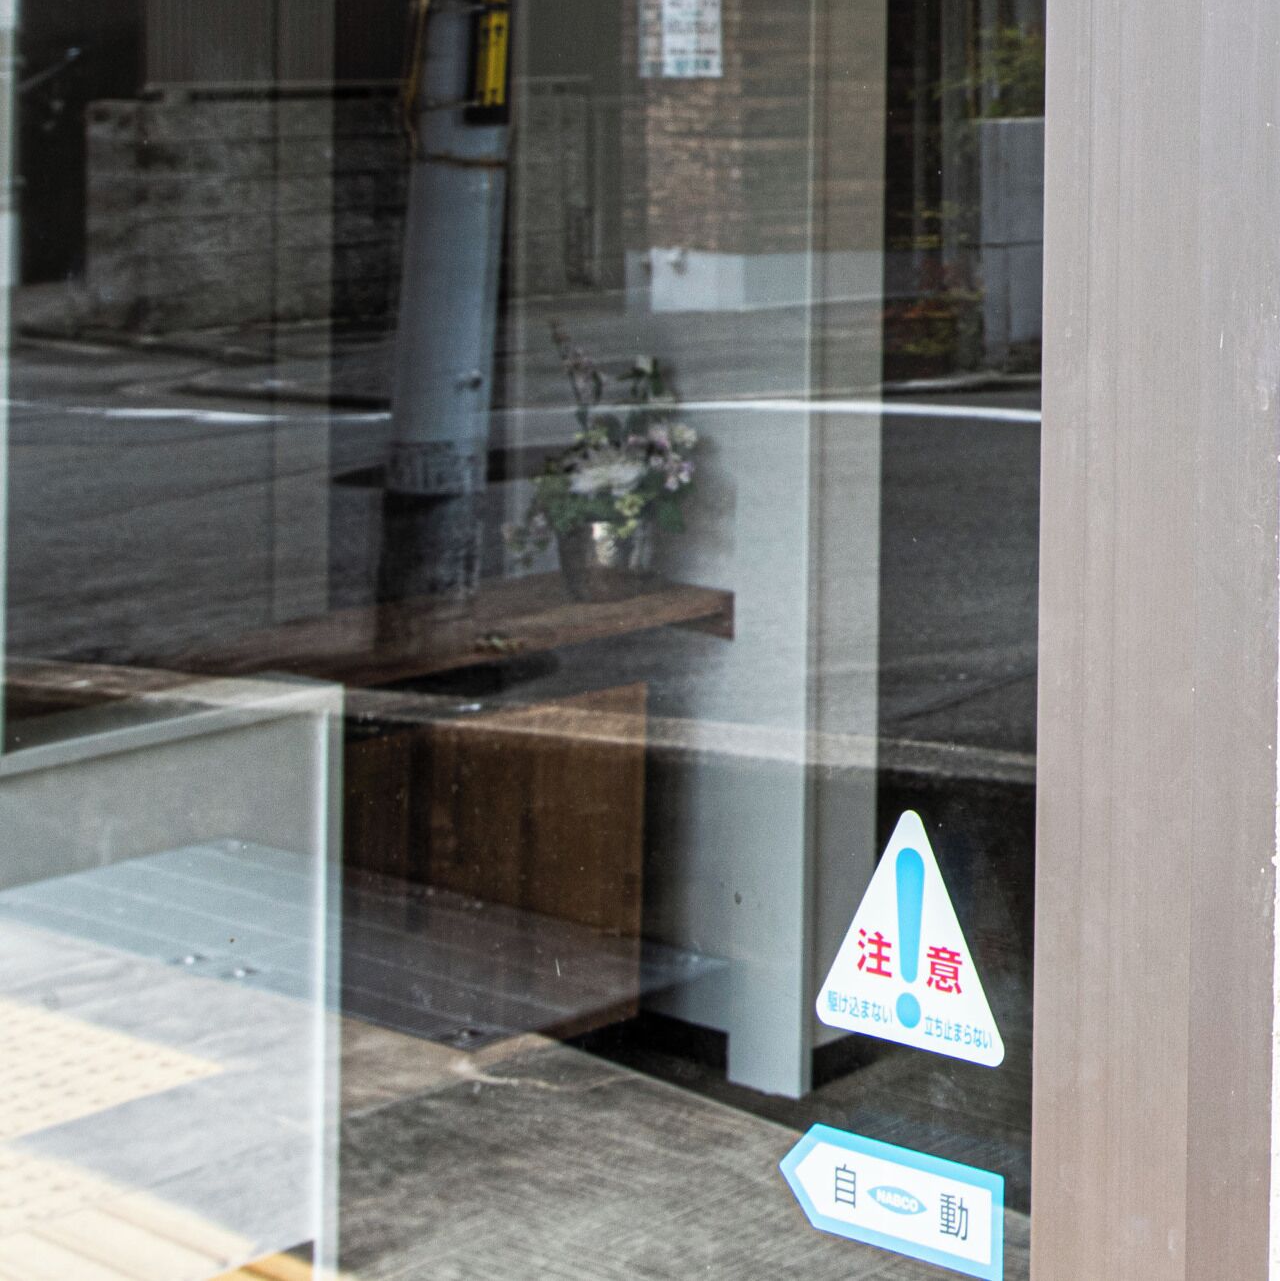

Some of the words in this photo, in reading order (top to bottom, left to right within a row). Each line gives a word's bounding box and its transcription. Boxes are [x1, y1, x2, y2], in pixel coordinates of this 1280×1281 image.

[924, 1015, 993, 1049] 立ち止まらない
